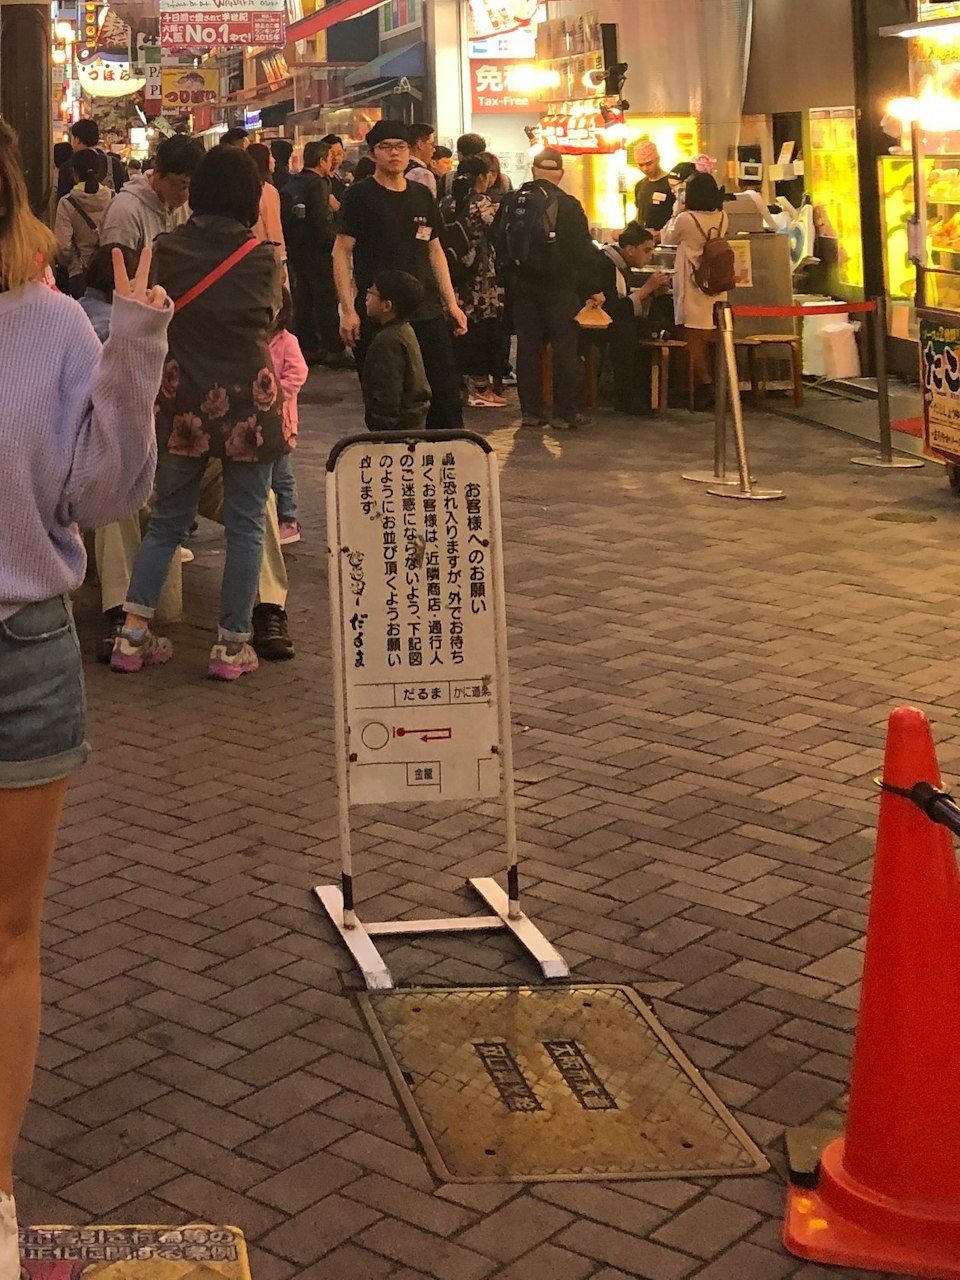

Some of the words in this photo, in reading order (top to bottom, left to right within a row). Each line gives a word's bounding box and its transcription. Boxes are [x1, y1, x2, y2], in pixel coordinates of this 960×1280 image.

[185, 23, 229, 44] No.1
[478, 96, 529, 107] Tax-Free
[465, 482, 487, 615] お客様へのお願い
[379, 454, 402, 667] のようにお並び頂くようお願い
[403, 687, 442, 701] だるま
